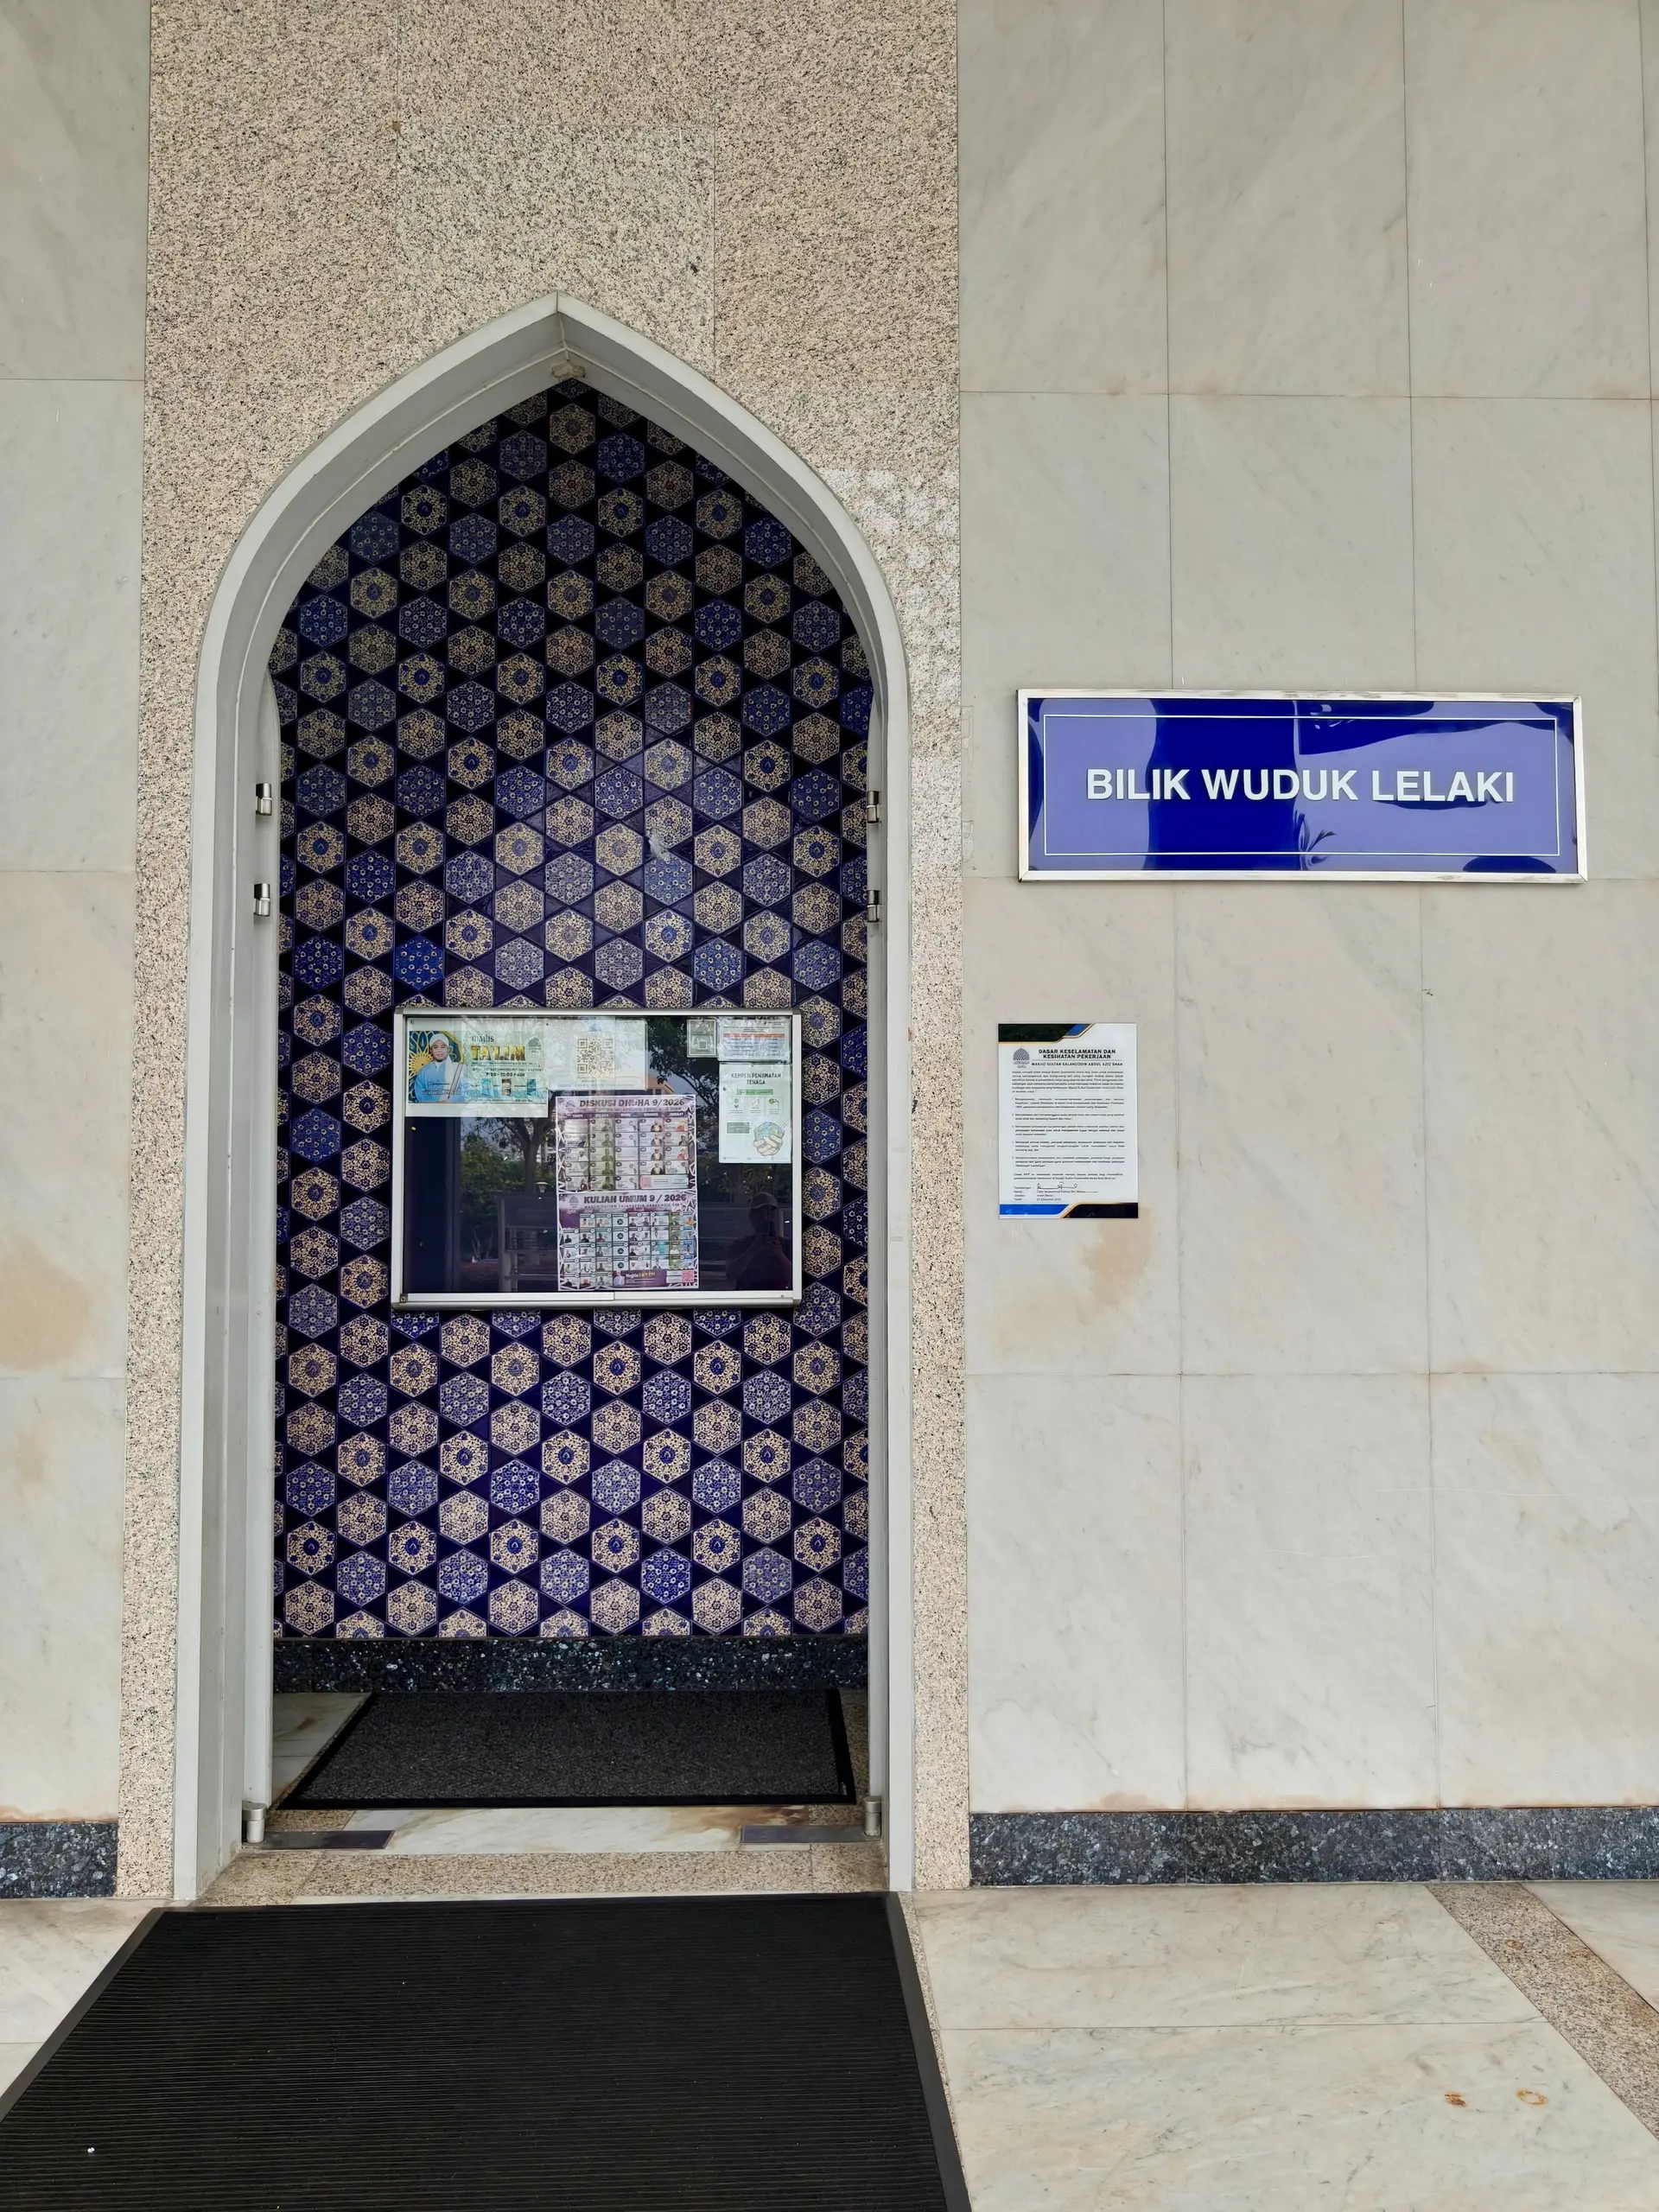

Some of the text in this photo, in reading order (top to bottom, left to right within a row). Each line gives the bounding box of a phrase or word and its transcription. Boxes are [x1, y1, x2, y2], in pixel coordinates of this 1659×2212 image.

[1086, 768, 1514, 803] BILIK WUDUK LELAKI
[579, 1098, 685, 1108] DISKUSI DHUHA 9/2026
[583, 1195, 617, 1204] KULIAH
[664, 1193, 687, 1202] 2026
